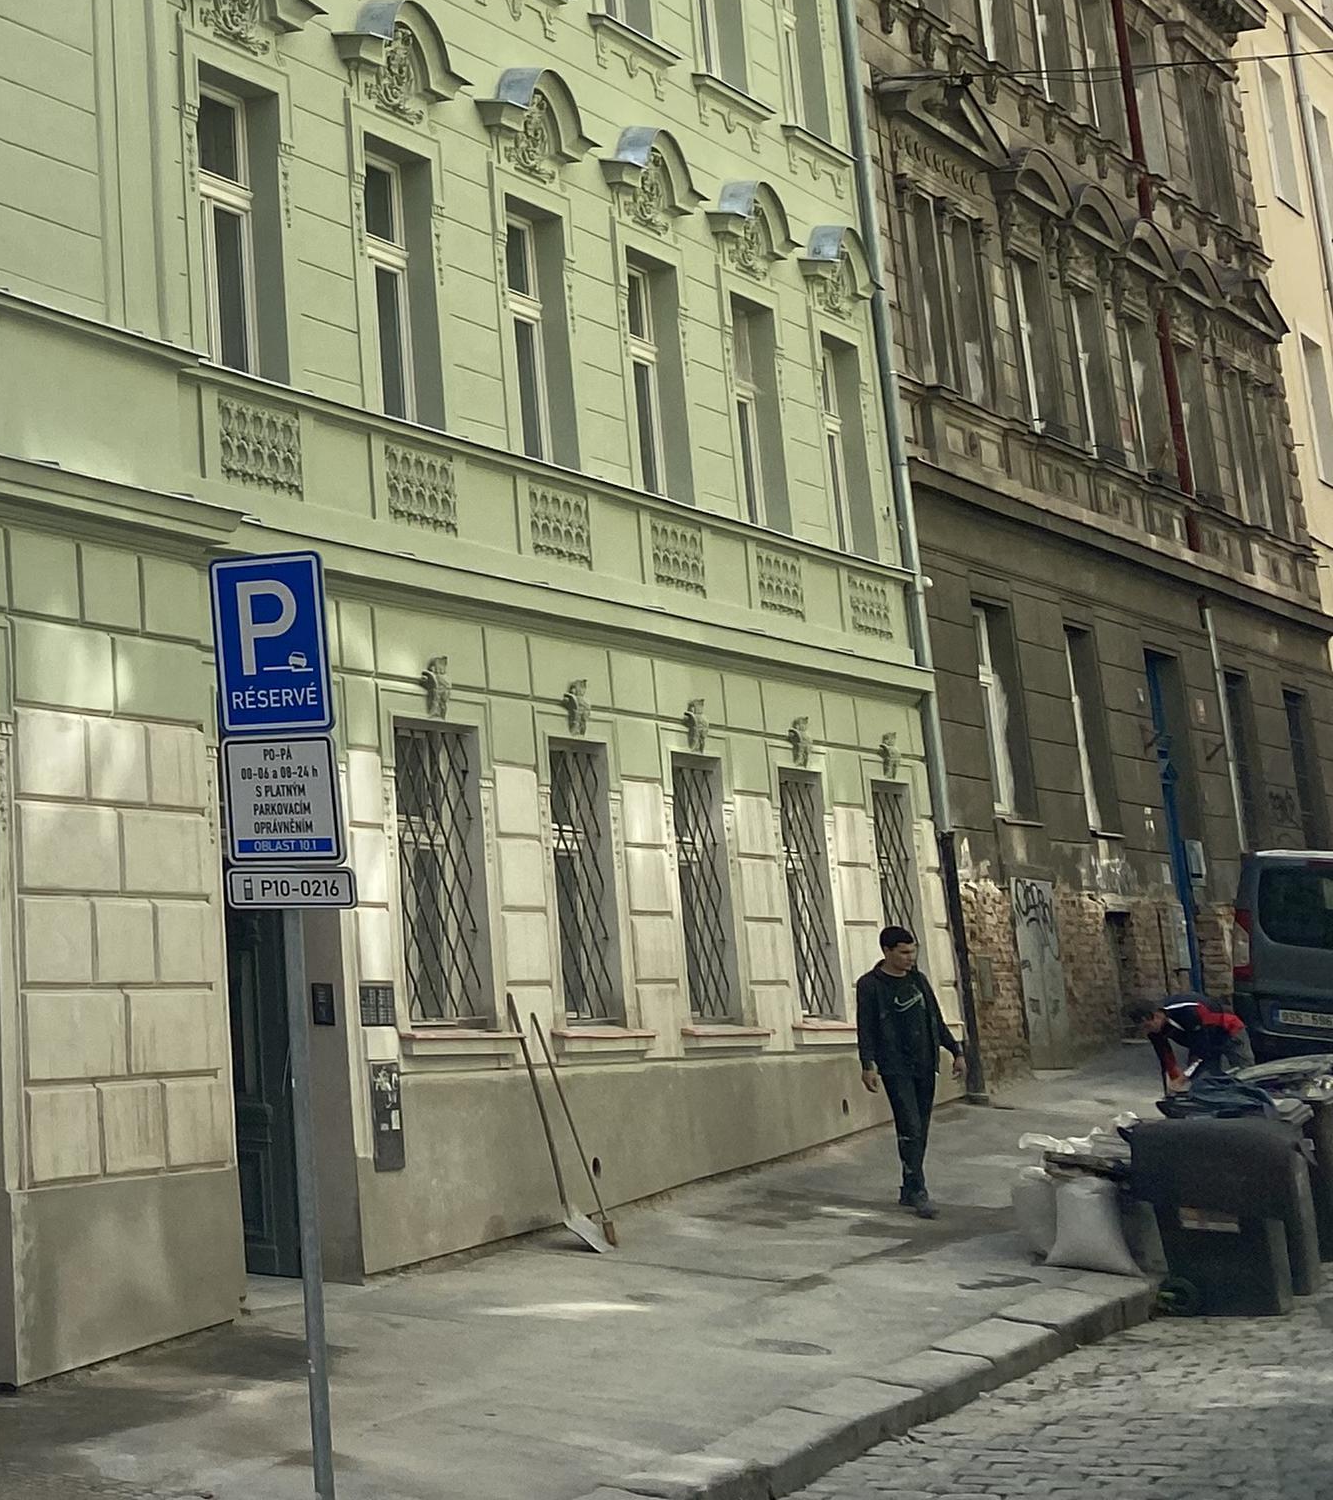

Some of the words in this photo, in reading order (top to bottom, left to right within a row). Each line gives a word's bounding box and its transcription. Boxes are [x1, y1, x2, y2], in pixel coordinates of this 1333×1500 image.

[236, 579, 297, 676] P
[232, 682, 318, 710] RÉSERVÉ
[262, 745, 293, 761] PO-PÁ
[240, 767, 270, 780] 00-06
[272, 769, 278, 779] a
[280, 765, 310, 779] 08-24
[312, 765, 318, 777] h
[255, 785, 263, 798] S
[264, 782, 307, 798] PLATNÝM
[253, 799, 312, 816] PARKOVACÍM
[253, 818, 314, 835] OPRÁVNĚNÍM
[254, 840, 296, 852] OBLAST
[260, 879, 340, 897] P10-0216
